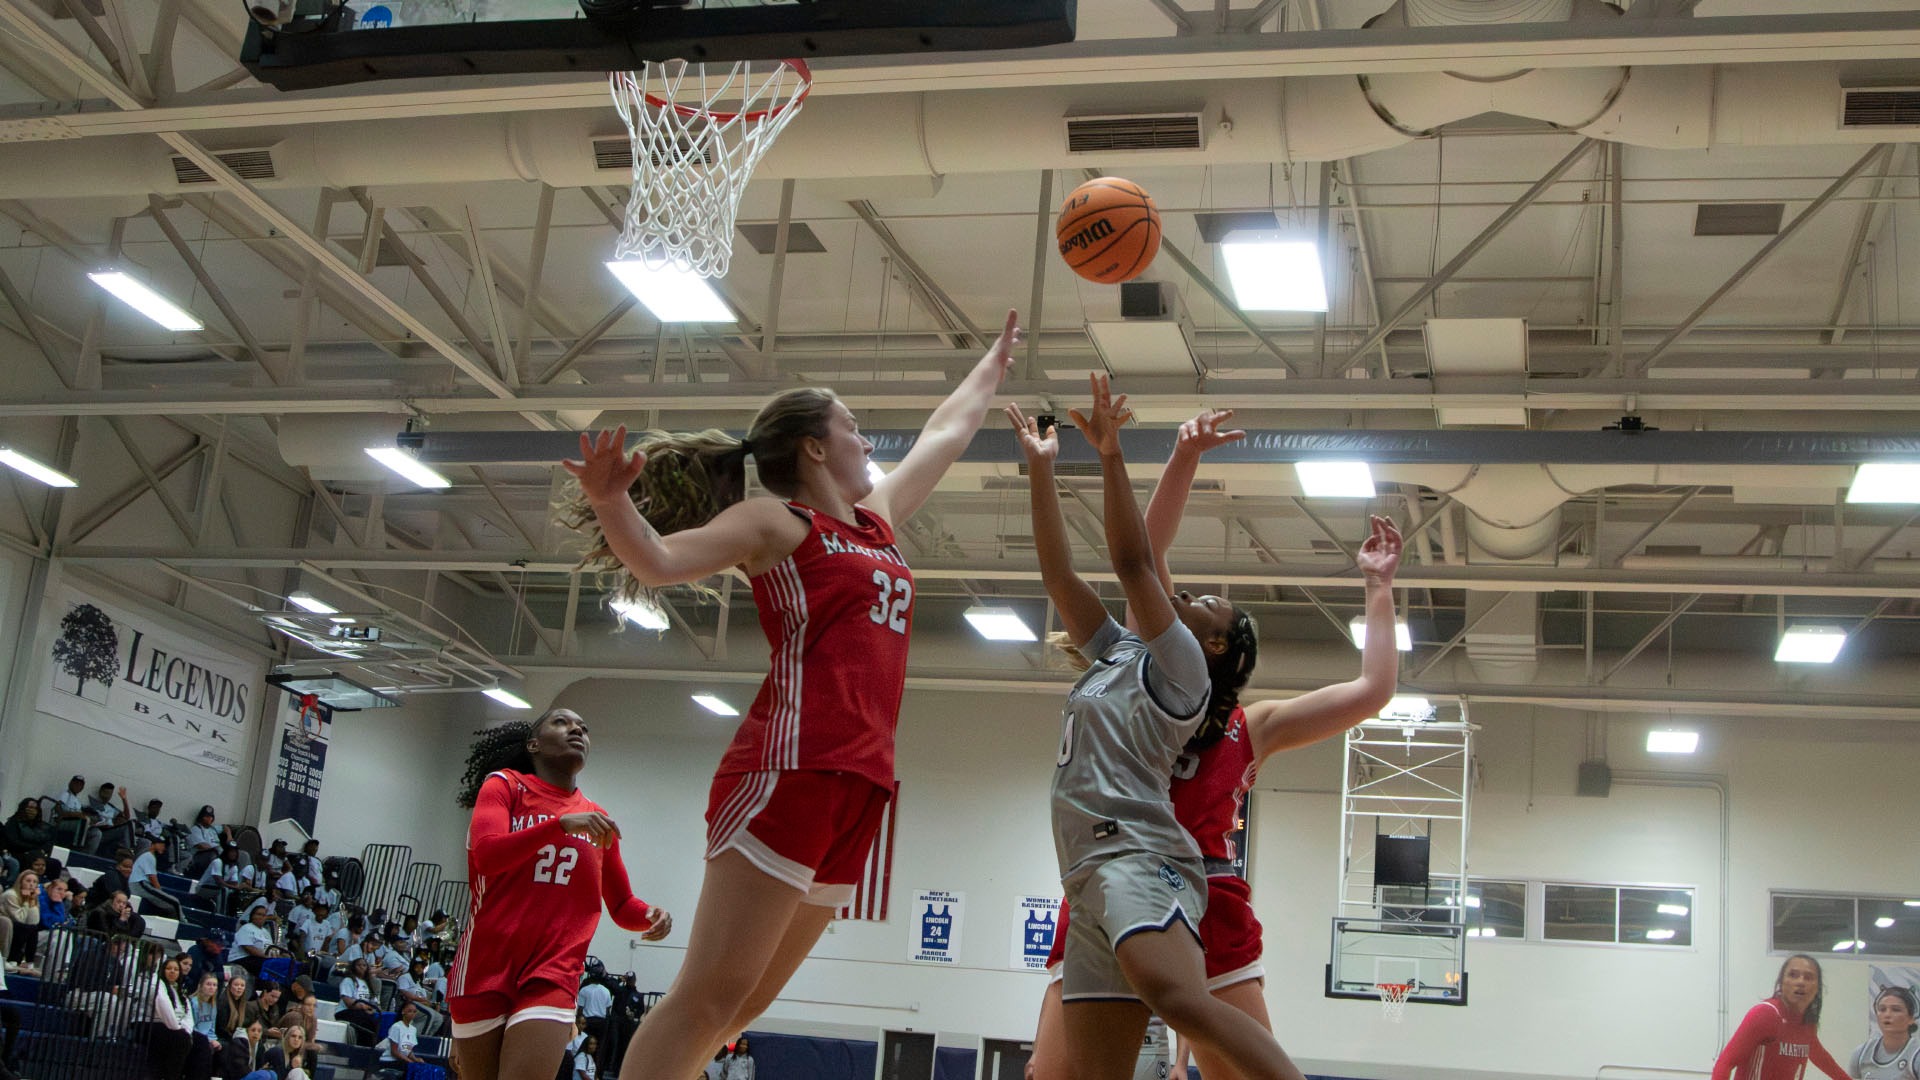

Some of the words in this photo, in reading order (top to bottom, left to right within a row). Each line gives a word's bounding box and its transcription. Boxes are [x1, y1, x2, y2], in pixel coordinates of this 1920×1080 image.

[869, 569, 912, 635] 32
[133, 702, 228, 743] BANK
[289, 772, 307, 784] 2007
[533, 844, 579, 886] 22
[930, 926, 942, 937] 24
[1027, 923, 1052, 931] LINCOLN
[1032, 932, 1044, 943] 41
